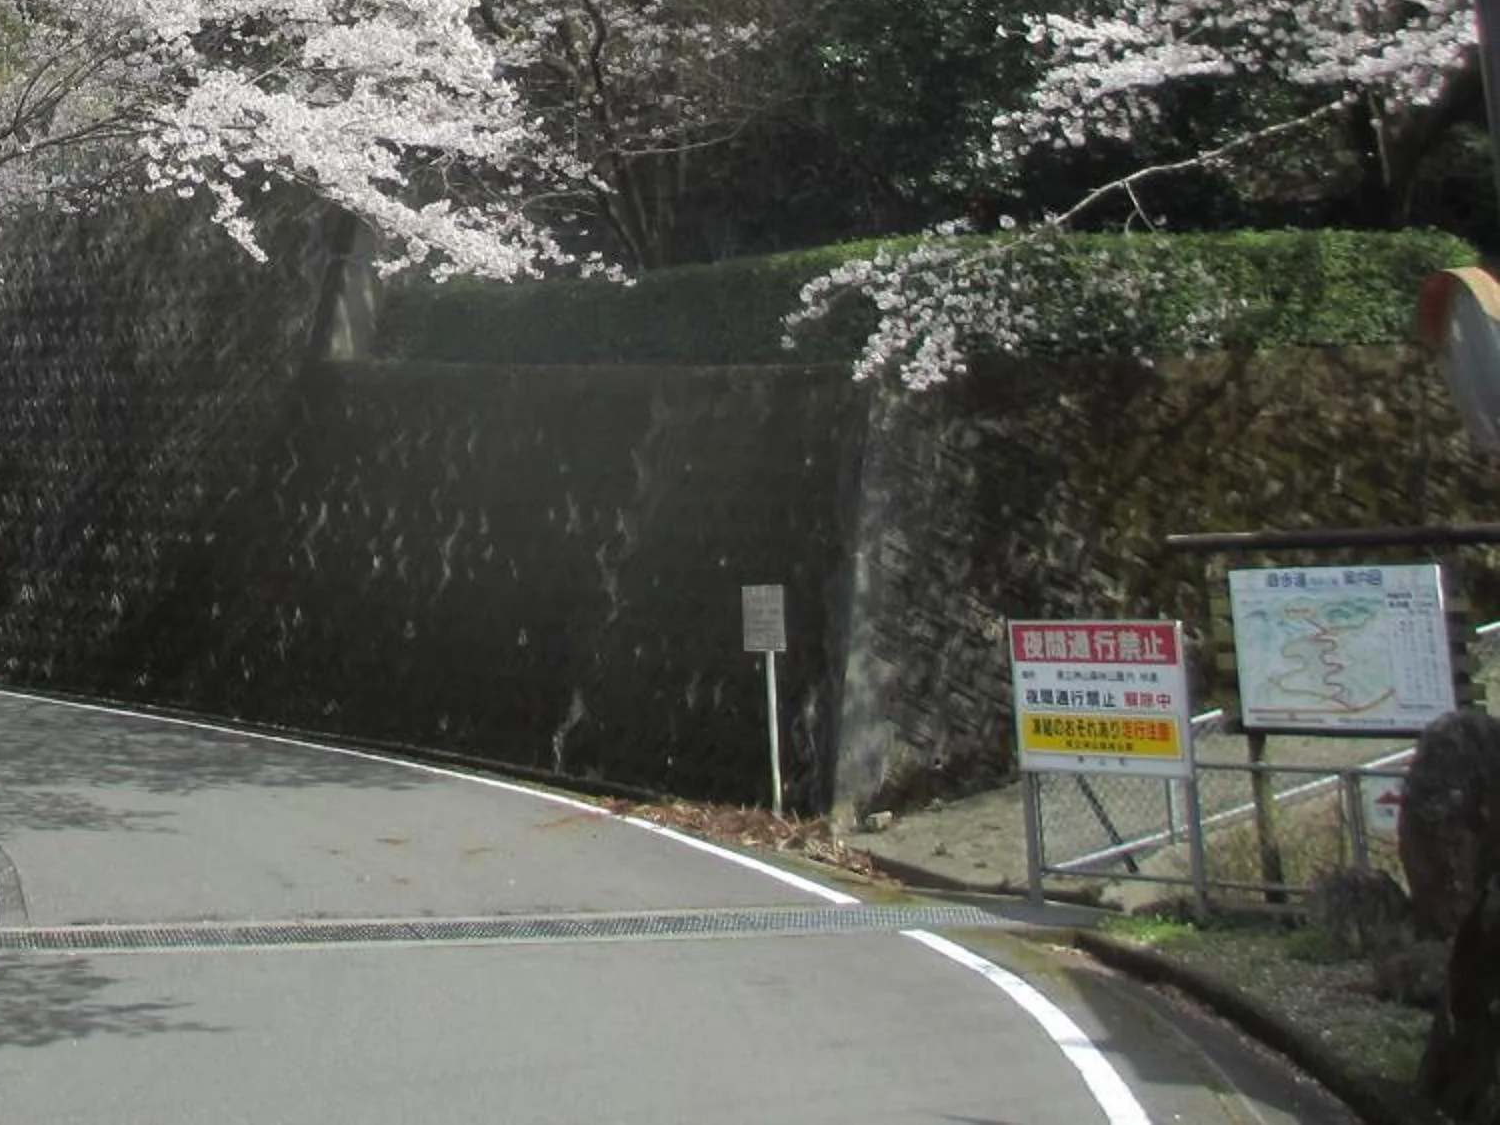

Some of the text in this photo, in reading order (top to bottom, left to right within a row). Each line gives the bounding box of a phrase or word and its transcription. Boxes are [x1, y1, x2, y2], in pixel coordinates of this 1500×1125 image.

[1021, 629, 1168, 662] 夜間通行禁止
[1025, 688, 1117, 708] 夜間通行禁止
